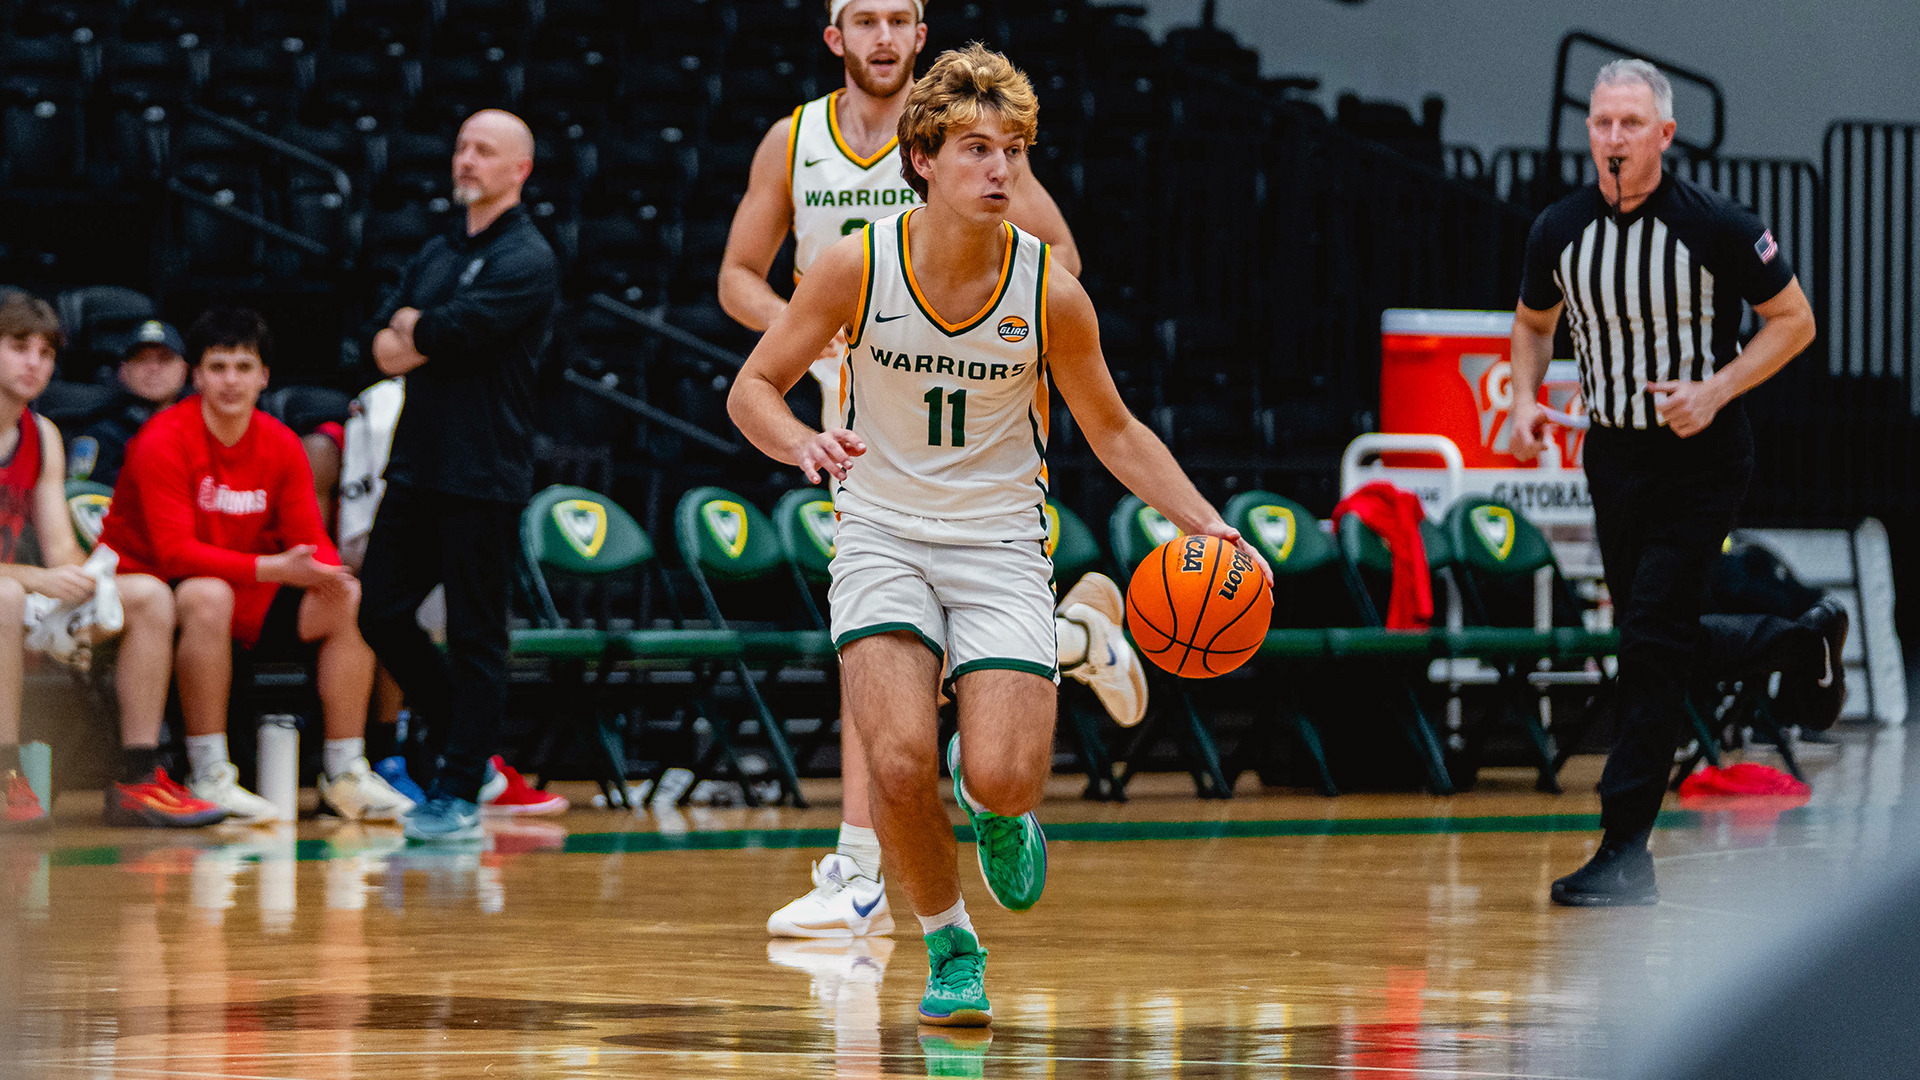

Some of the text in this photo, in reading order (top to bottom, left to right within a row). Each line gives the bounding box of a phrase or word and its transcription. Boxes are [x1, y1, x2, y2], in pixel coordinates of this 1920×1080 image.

[805, 189, 928, 207] WARRIOR
[1000, 326, 1028, 336] GLIAC
[869, 344, 1028, 381] WARRIORS
[923, 386, 967, 448] 11
[1492, 481, 1592, 507] GATORA
